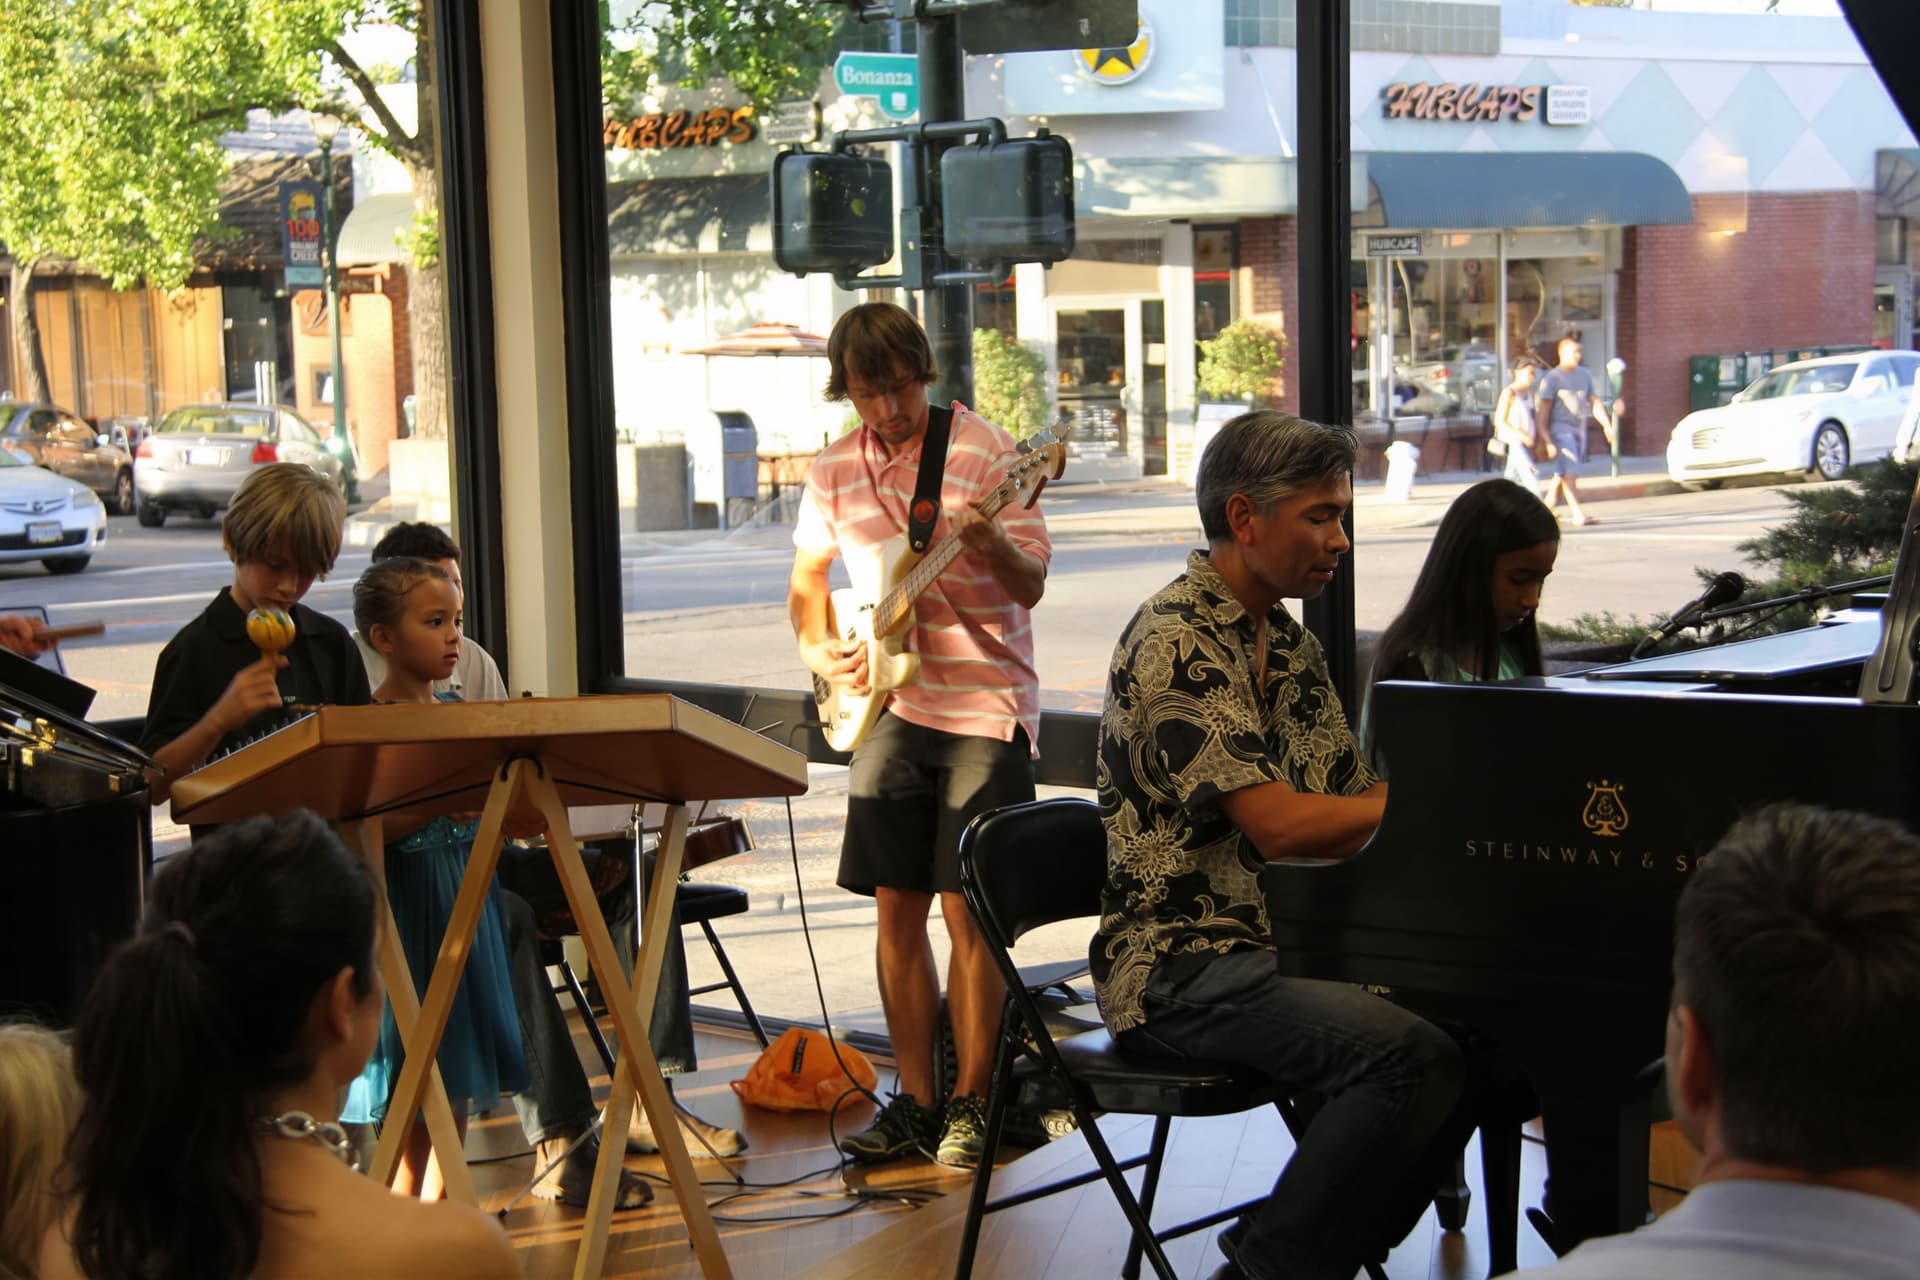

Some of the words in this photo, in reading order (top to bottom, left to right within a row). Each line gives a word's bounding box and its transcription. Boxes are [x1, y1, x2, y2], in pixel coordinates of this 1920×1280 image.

[842, 65, 913, 86] Bonanza
[1384, 82, 1541, 121] HUBCAPS
[286, 219, 320, 237] 100
[1369, 238, 1417, 249] HUBCAPS
[1464, 839, 1622, 866] STEINWAY
[1641, 852, 1654, 869] &
